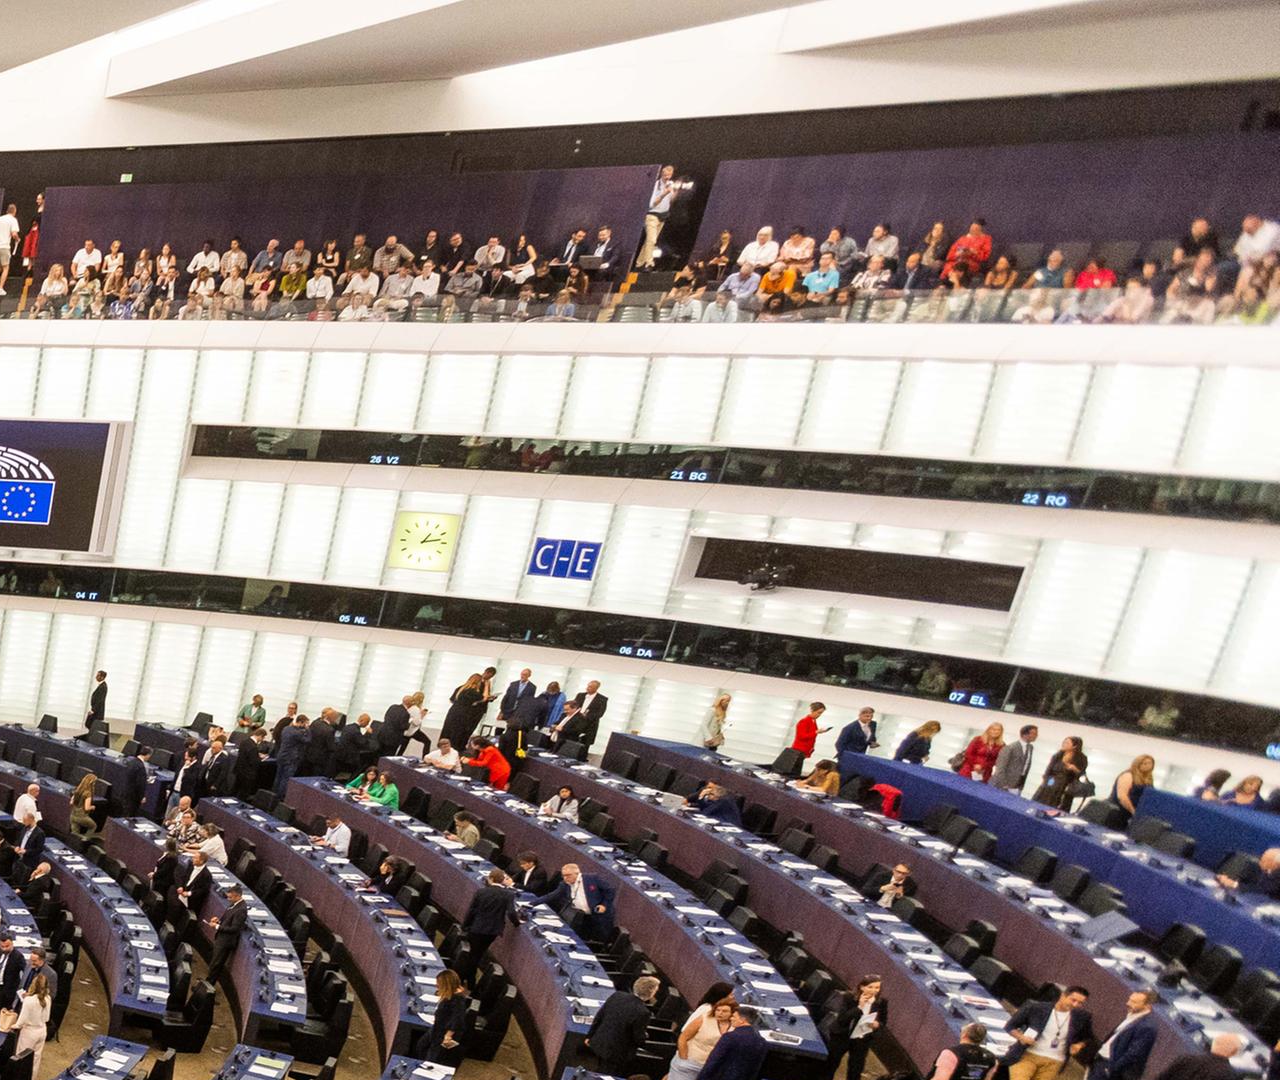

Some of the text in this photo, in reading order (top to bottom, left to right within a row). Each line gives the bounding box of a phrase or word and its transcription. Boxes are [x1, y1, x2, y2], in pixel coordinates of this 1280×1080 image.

[669, 470, 707, 481] 21 BG
[1021, 492, 1068, 508] 22 RO
[535, 544, 595, 573] C-E
[74, 591, 98, 600] 04 IT
[338, 614, 368, 625] 05 NL
[618, 646, 653, 658] 06 DA
[948, 691, 986, 707] 07 EL
